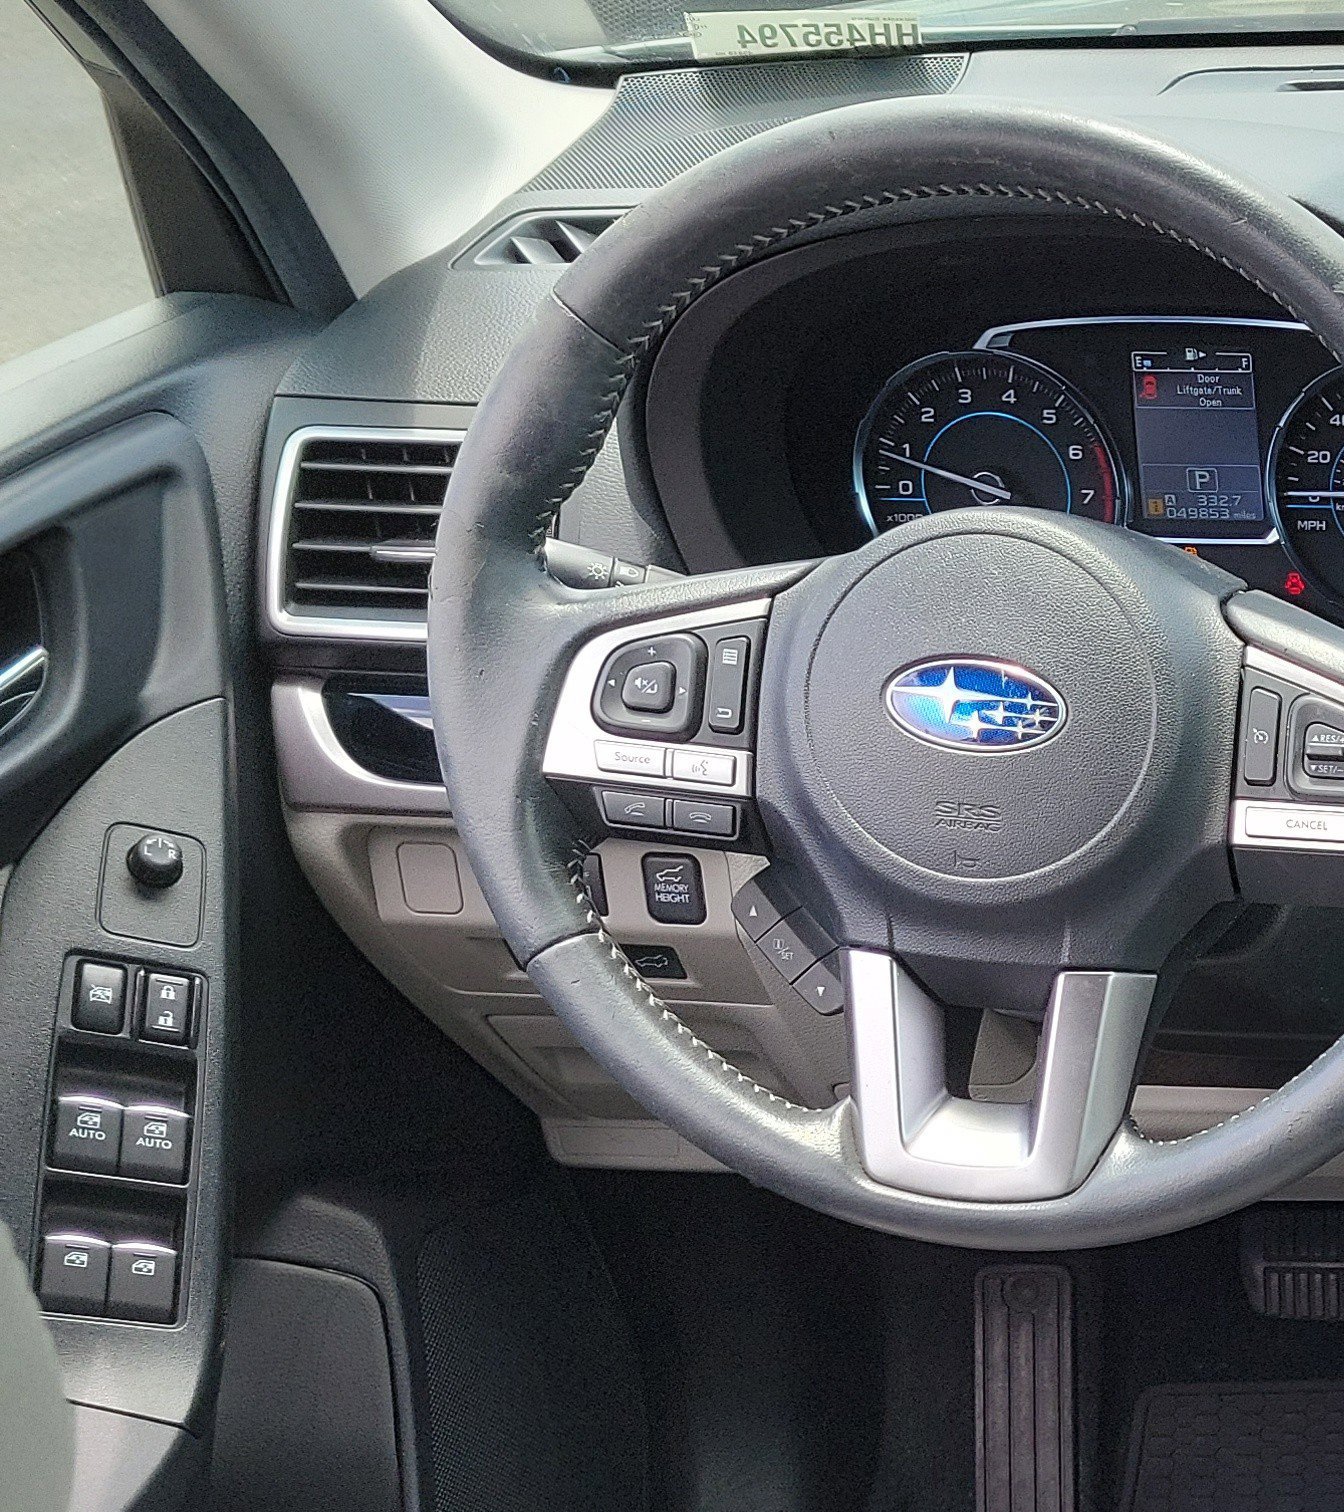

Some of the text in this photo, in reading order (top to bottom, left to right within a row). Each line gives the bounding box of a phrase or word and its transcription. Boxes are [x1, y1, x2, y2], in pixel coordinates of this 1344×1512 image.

[1135, 356, 1142, 367] E
[1241, 358, 1249, 368] F
[1197, 374, 1220, 383] Door
[958, 389, 971, 403] 3
[1001, 389, 1017, 403] 4
[1176, 385, 1243, 396] Liftgate/Trunk
[1199, 398, 1222, 408] Open
[921, 408, 935, 422] 2
[1042, 409, 1056, 424] 5
[902, 443, 910, 456] 1
[1068, 445, 1083, 459] 6
[1307, 450, 1331, 463] 20
[1194, 471, 1210, 490] P
[899, 480, 913, 495] 0
[1080, 490, 1094, 504] 7
[1166, 507, 1230, 519] 049853
[1297, 520, 1326, 531] MPH
[614, 752, 651, 765] Source
[935, 800, 1001, 819] SRS
[934, 818, 1001, 832] AIRBAG
[1286, 819, 1328, 831] CANCEL
[144, 845, 152, 856] L
[168, 848, 177, 860] R
[654, 882, 690, 892] MEMORY
[655, 892, 690, 903] HEIGHT
[68, 1128, 106, 1141] AUTO
[135, 1137, 173, 1150] AUTO
